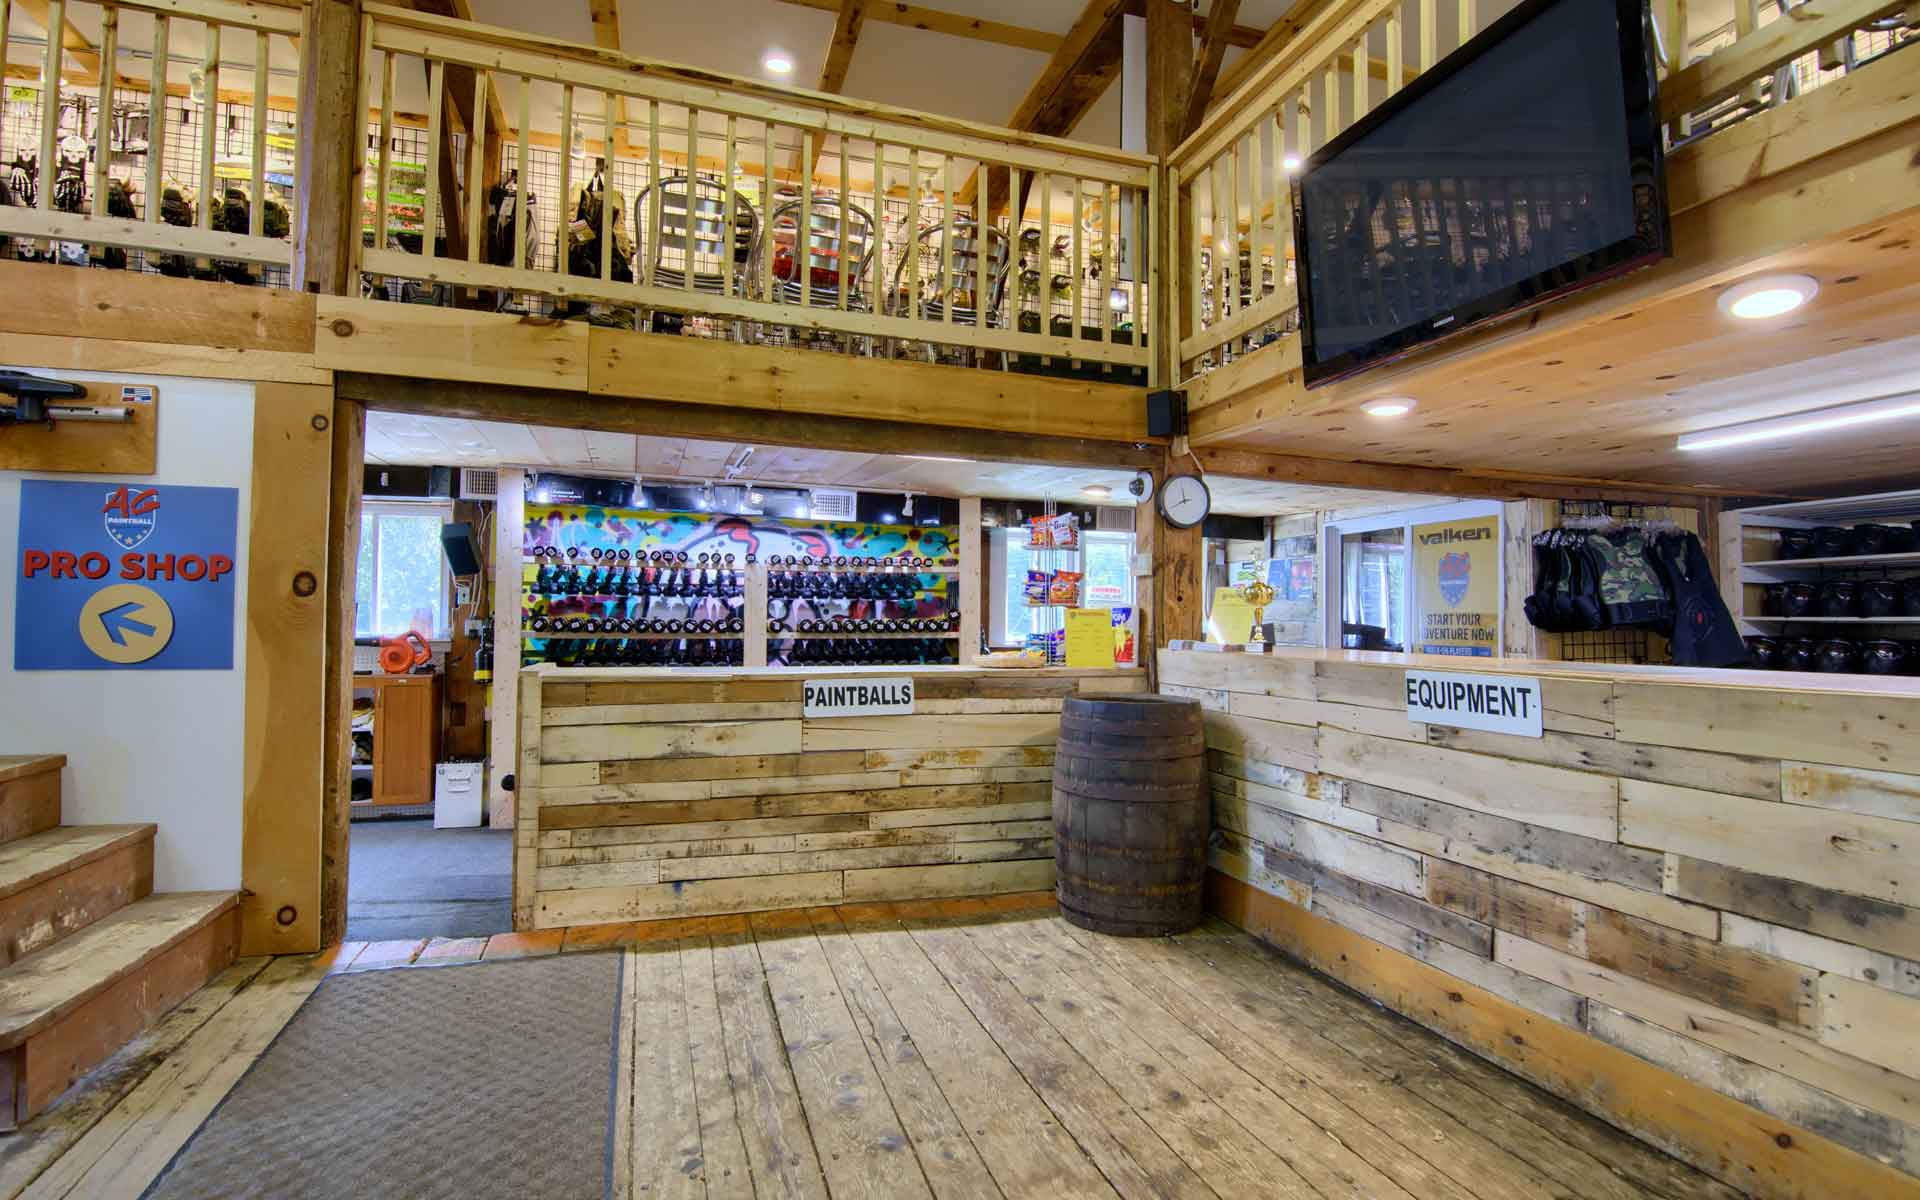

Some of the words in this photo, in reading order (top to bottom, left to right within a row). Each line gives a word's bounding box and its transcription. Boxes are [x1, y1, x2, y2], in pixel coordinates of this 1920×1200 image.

[102, 486, 160, 519] AG
[23, 549, 111, 580] PRO
[119, 552, 233, 582] SHOP
[1427, 613, 1454, 625] START
[1455, 612, 1481, 625] YOUR
[1471, 626, 1495, 641] NOW
[804, 685, 912, 707] PAINTBALLS
[1406, 678, 1532, 719] EQUIPMENT
